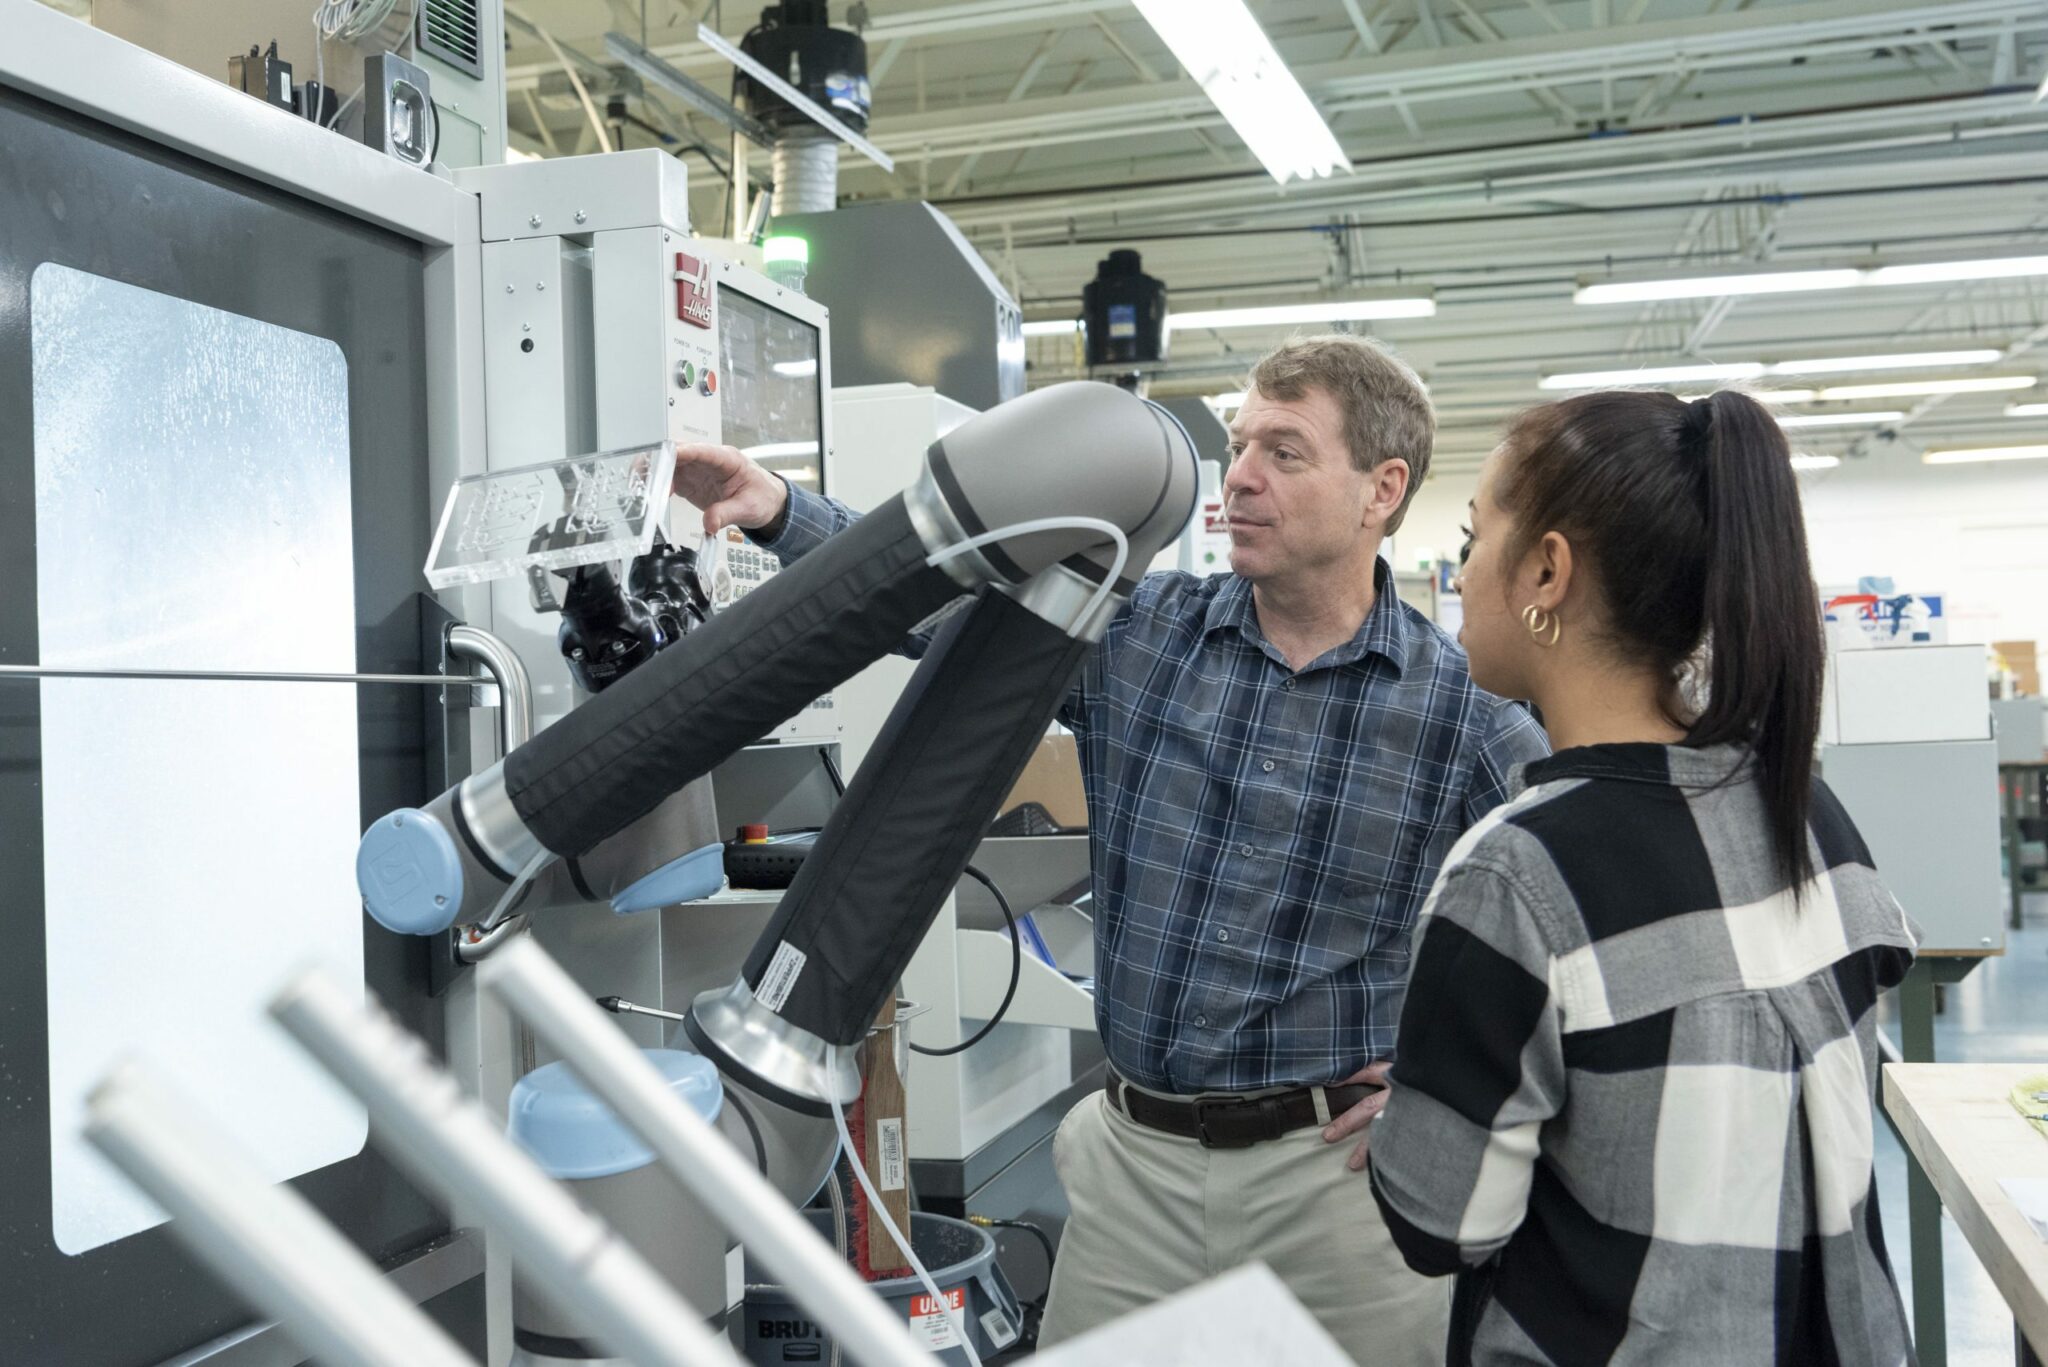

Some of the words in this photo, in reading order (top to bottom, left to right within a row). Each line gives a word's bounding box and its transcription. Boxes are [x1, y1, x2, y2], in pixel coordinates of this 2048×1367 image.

[683, 299, 712, 322] HAAS
[920, 1291, 959, 1314] ULNE
[759, 1320, 822, 1338] BRUT
